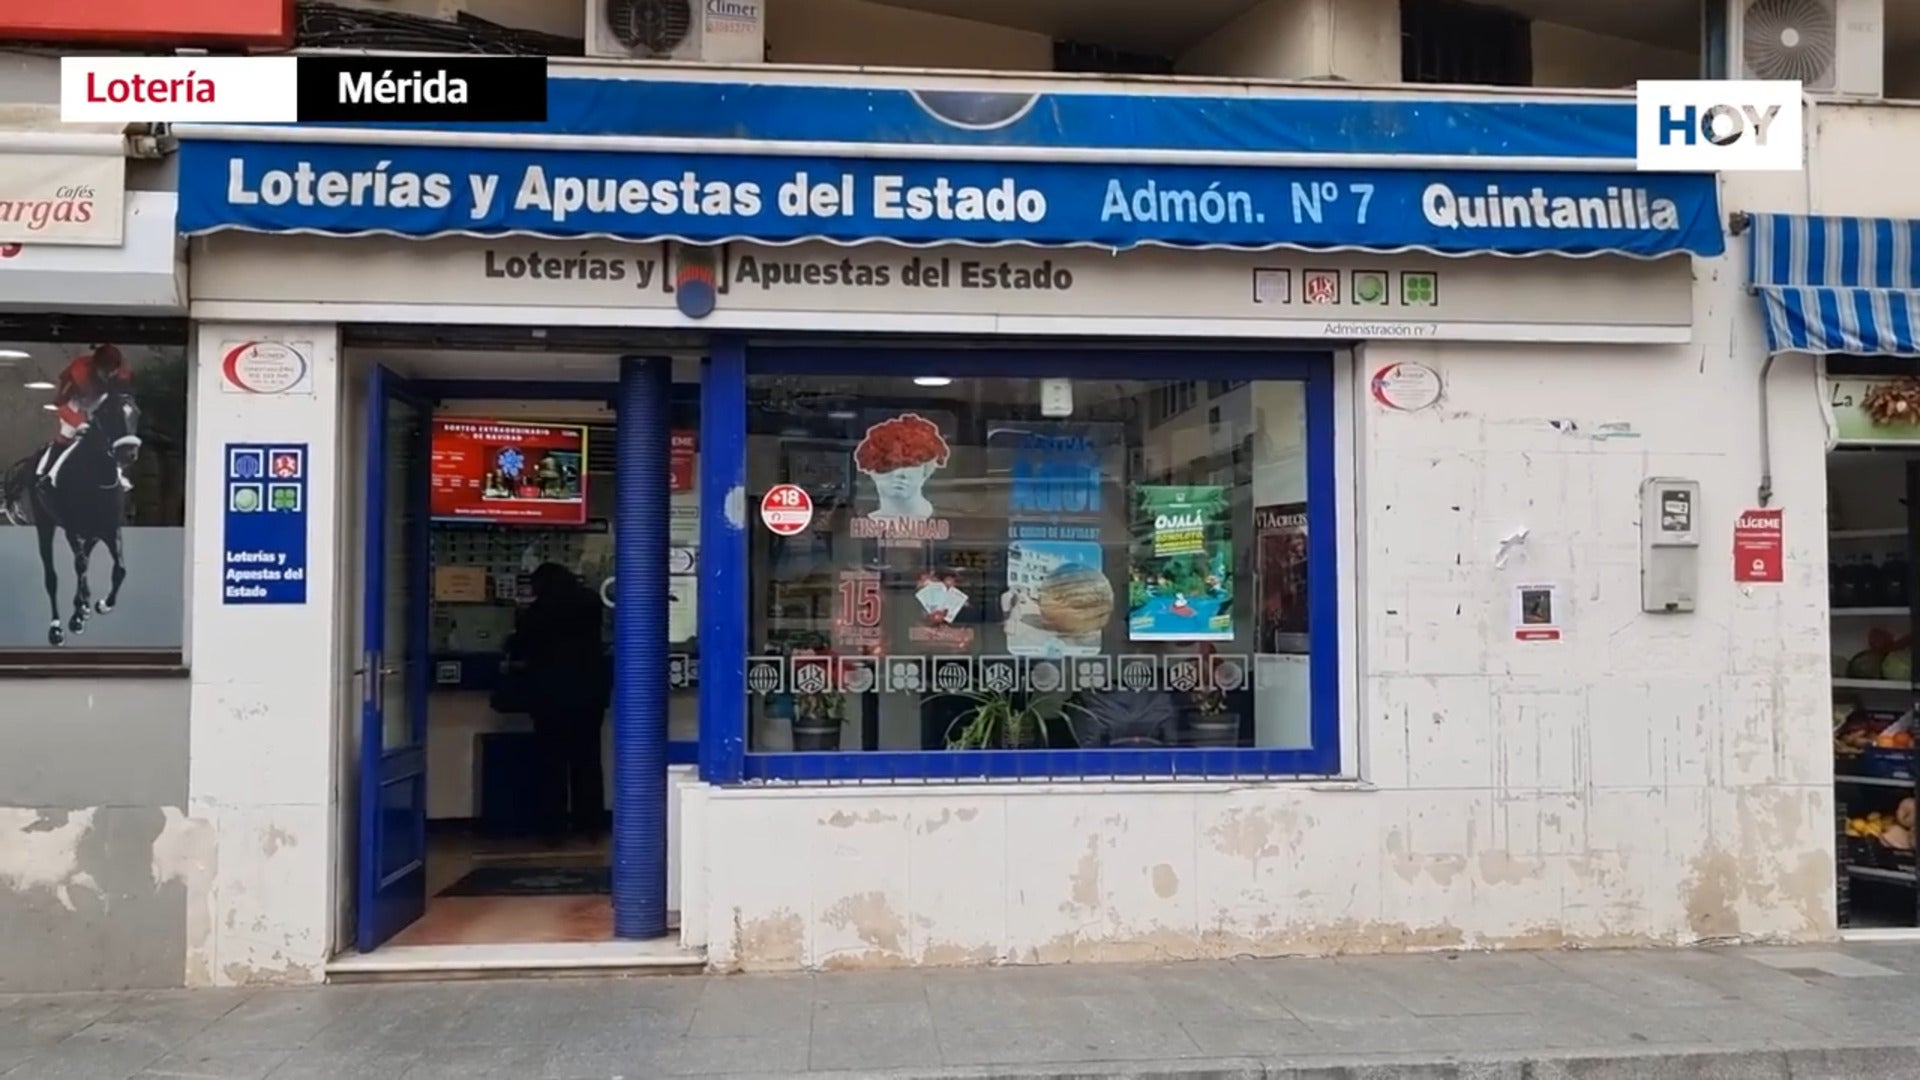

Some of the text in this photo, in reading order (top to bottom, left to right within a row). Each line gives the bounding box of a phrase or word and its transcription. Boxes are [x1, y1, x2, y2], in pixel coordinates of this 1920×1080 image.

[56, 186, 95, 200] Cafés
[229, 158, 1047, 222] Loterías y Apuestas del Estado
[1101, 180, 1265, 223] Admón.
[1349, 183, 1374, 224] 7
[1422, 183, 1678, 231] Quintanilla
[486, 251, 655, 289] Loterías y
[736, 256, 1073, 290] Apuestas del Estado
[1324, 322, 1411, 335] Administración
[1430, 325, 1438, 336] 7
[1832, 383, 1853, 407] La
[444, 424, 477, 432] SORTEO
[479, 425, 550, 436] EXTRAORDINARIO
[771, 490, 800, 506] +18
[1154, 509, 1204, 529] OJALÁ
[226, 550, 287, 565] Loterías y
[226, 568, 303, 582] Apuestas del
[226, 586, 267, 597] Estado
[839, 580, 881, 626] 15
